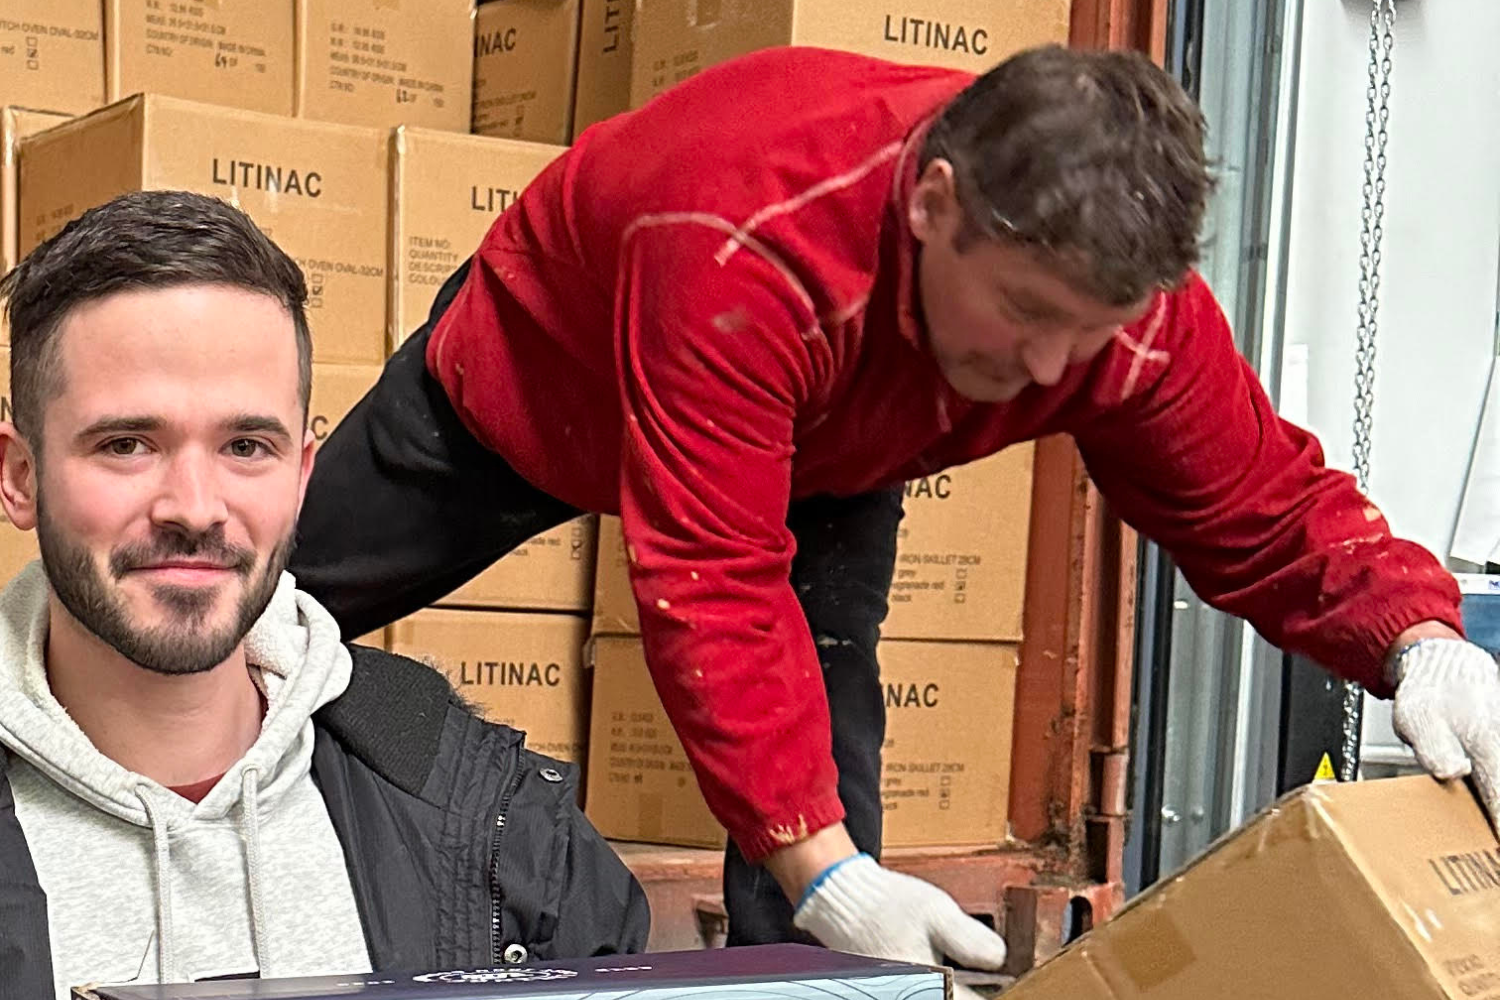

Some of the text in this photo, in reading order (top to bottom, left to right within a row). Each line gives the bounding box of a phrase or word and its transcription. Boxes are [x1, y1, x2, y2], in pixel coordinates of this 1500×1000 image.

[884, 15, 989, 56] LITINAC
[212, 158, 322, 198] LITINAC
[461, 661, 560, 687] LITINAC
